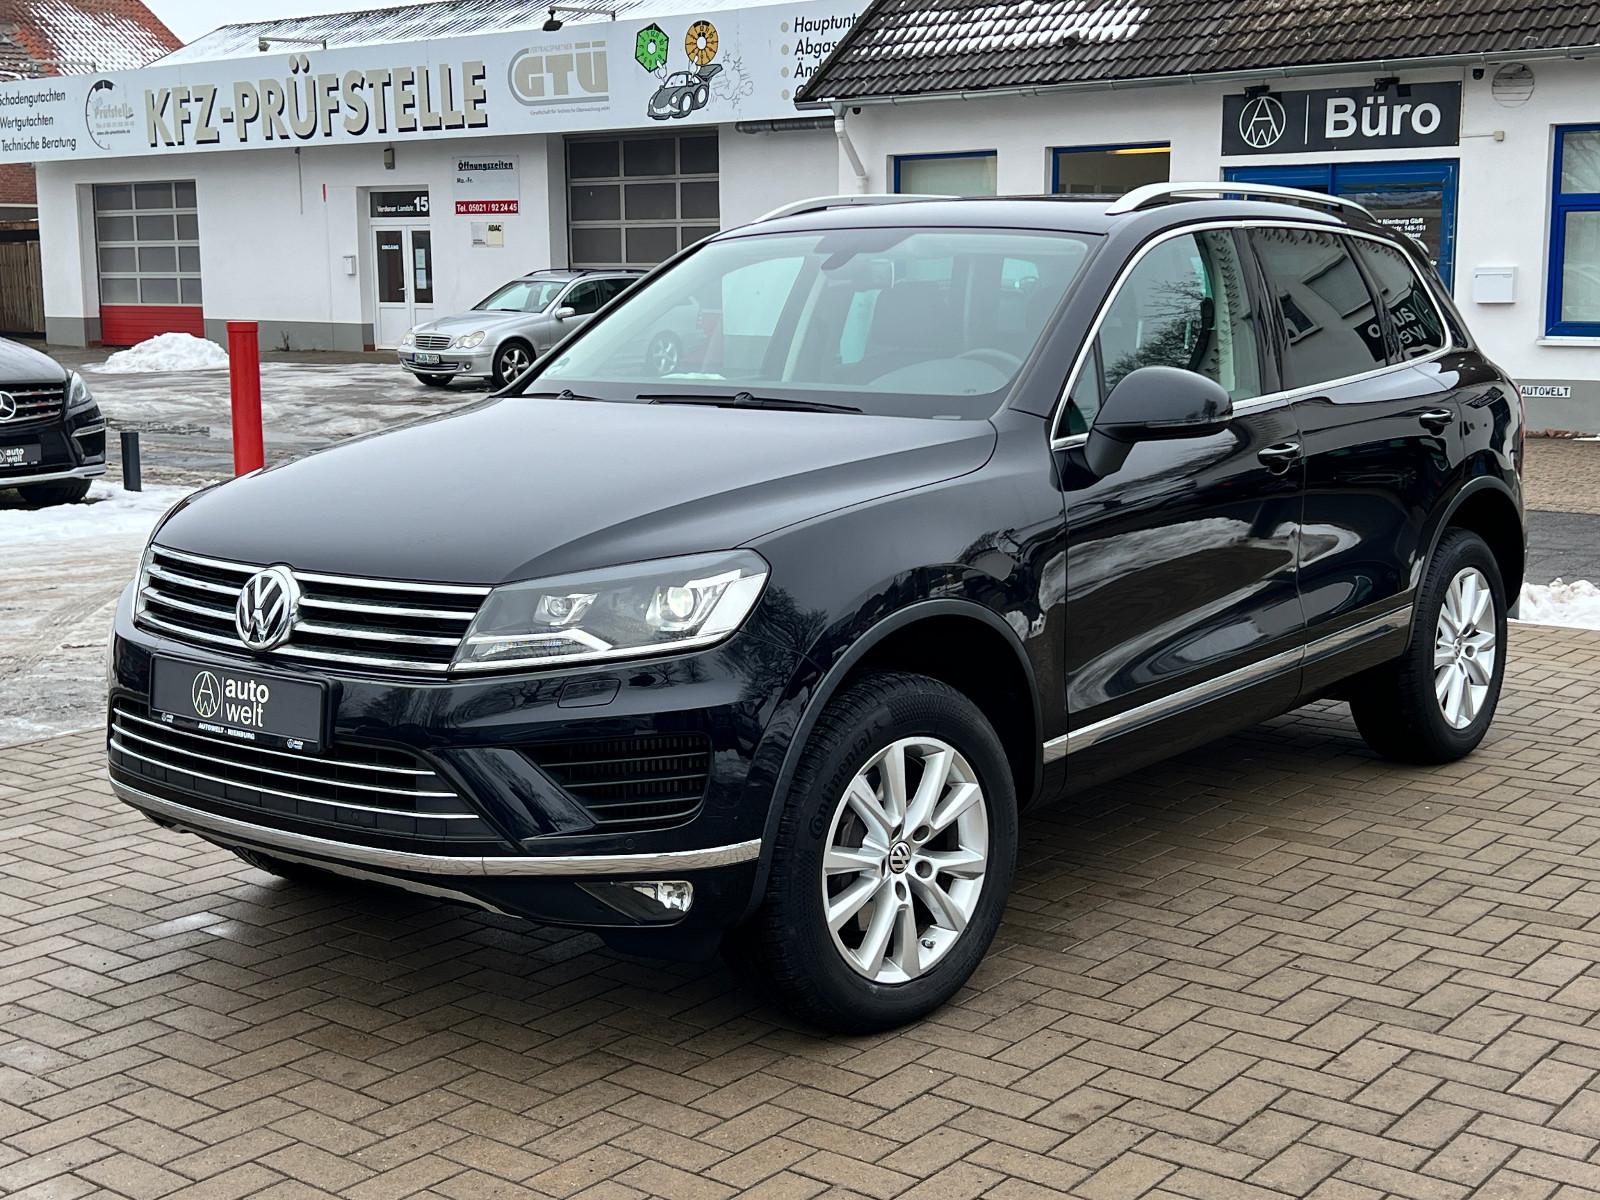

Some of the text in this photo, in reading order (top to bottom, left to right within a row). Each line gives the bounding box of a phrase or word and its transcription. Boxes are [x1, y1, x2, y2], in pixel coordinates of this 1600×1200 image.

[512, 40, 609, 98] GTÜ
[144, 54, 489, 148] KFZ-PRÜFSTELLE
[0, 113, 54, 132] Wertgutachten
[1324, 95, 1442, 139] Büro
[2, 136, 77, 152] Technische Beratung
[458, 159, 513, 171] Öffnungszeiten
[414, 196, 429, 212] 15
[491, 203, 499, 212] 92
[500, 203, 508, 212] 24
[509, 203, 518, 212] 45
[1520, 386, 1569, 397] AUTOWELT
[6, 448, 24, 456] auto
[7, 454, 23, 463] welt
[225, 678, 270, 704] auto
[225, 701, 264, 728] welt
